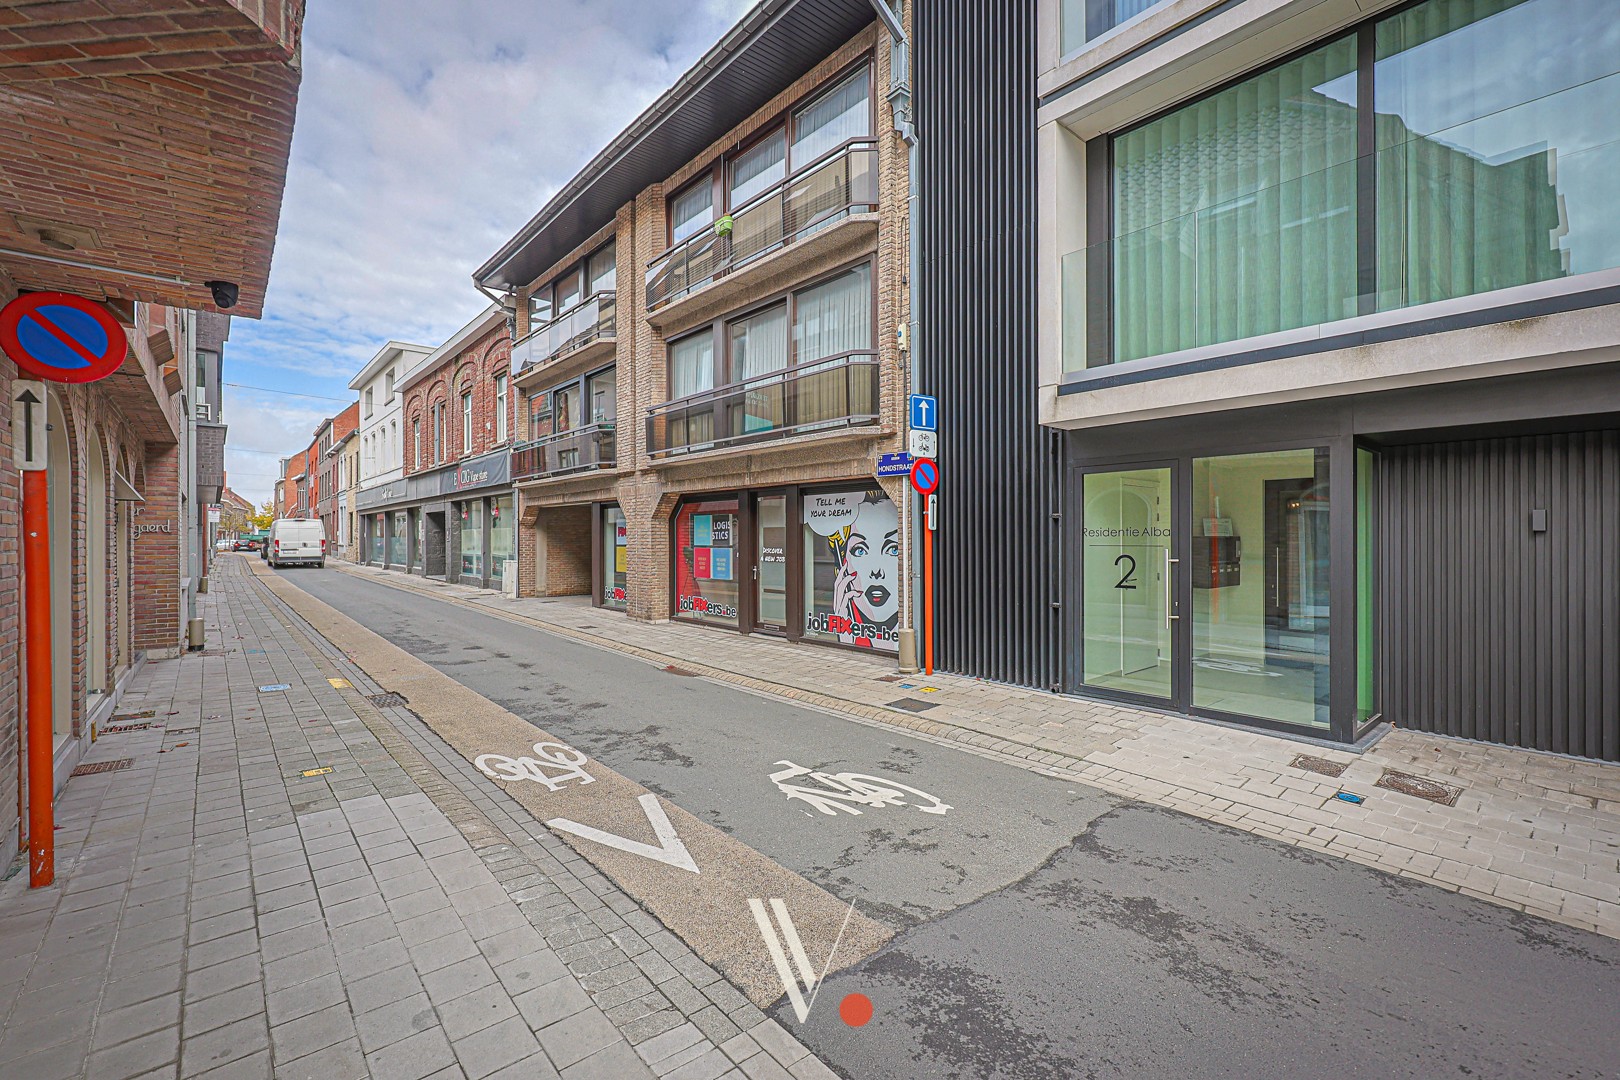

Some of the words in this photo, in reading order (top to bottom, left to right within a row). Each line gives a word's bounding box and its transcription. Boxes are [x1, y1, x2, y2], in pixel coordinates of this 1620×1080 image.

[816, 497, 833, 507] TELL
[834, 497, 846, 506] ME
[810, 509, 827, 518] YOUR
[828, 508, 852, 517] DREAM
[1082, 526, 1140, 538] Residentie
[1141, 526, 1172, 538] Alba
[1114, 554, 1137, 590] 2
